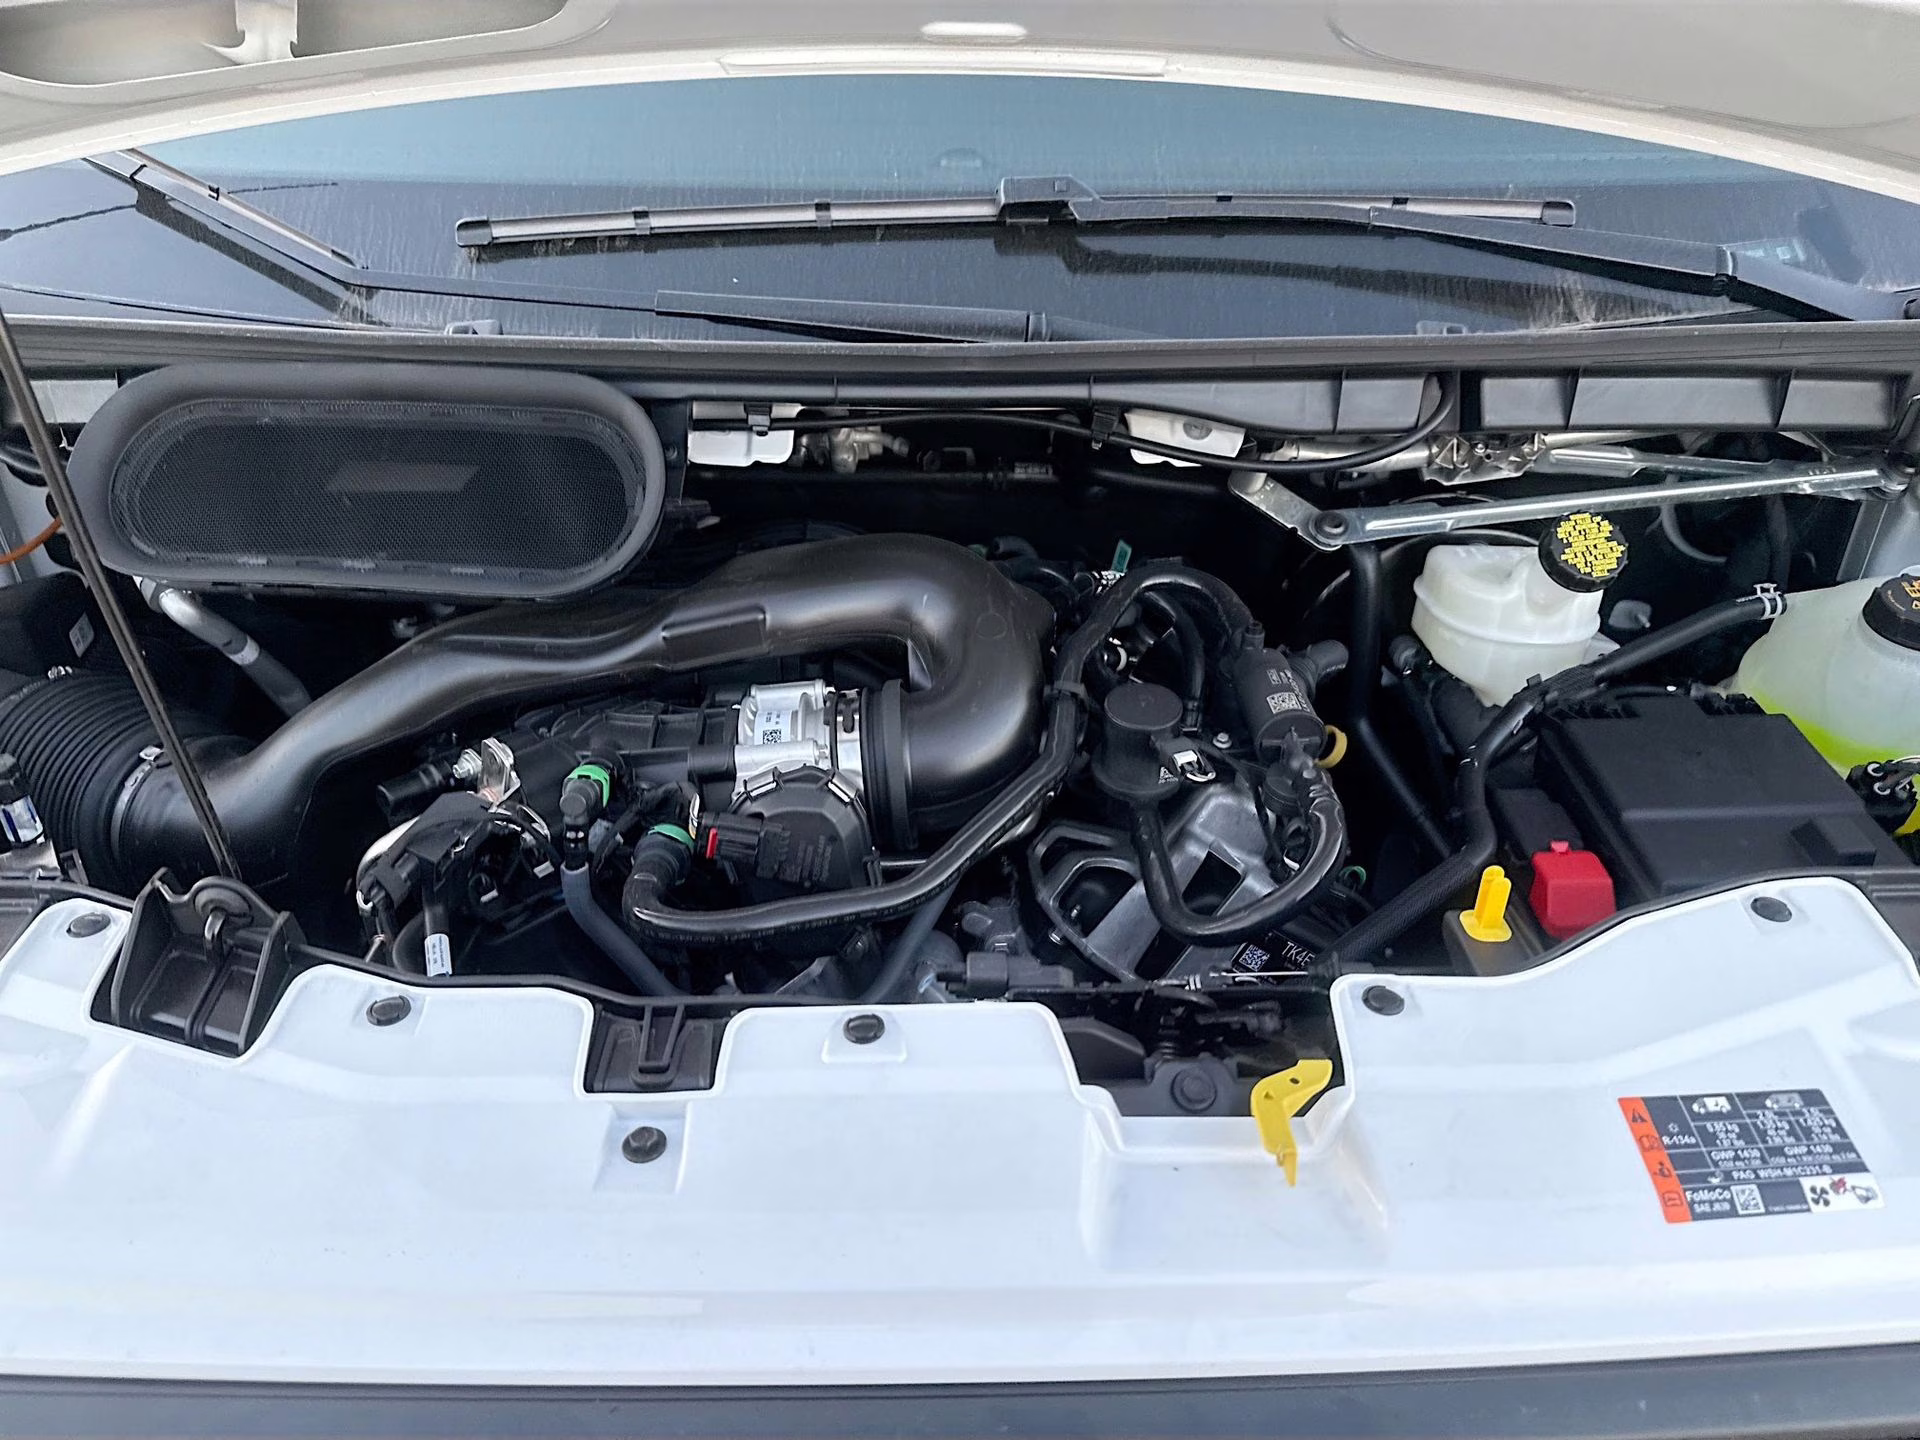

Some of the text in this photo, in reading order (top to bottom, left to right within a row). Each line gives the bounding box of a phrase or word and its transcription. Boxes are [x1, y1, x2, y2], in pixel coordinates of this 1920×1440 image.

[1711, 1149, 1735, 1160] GWP
[1784, 1145, 1808, 1156] GWP
[1732, 1169, 1755, 1180] PAG
[1685, 1188, 1732, 1202] FoMoCo
